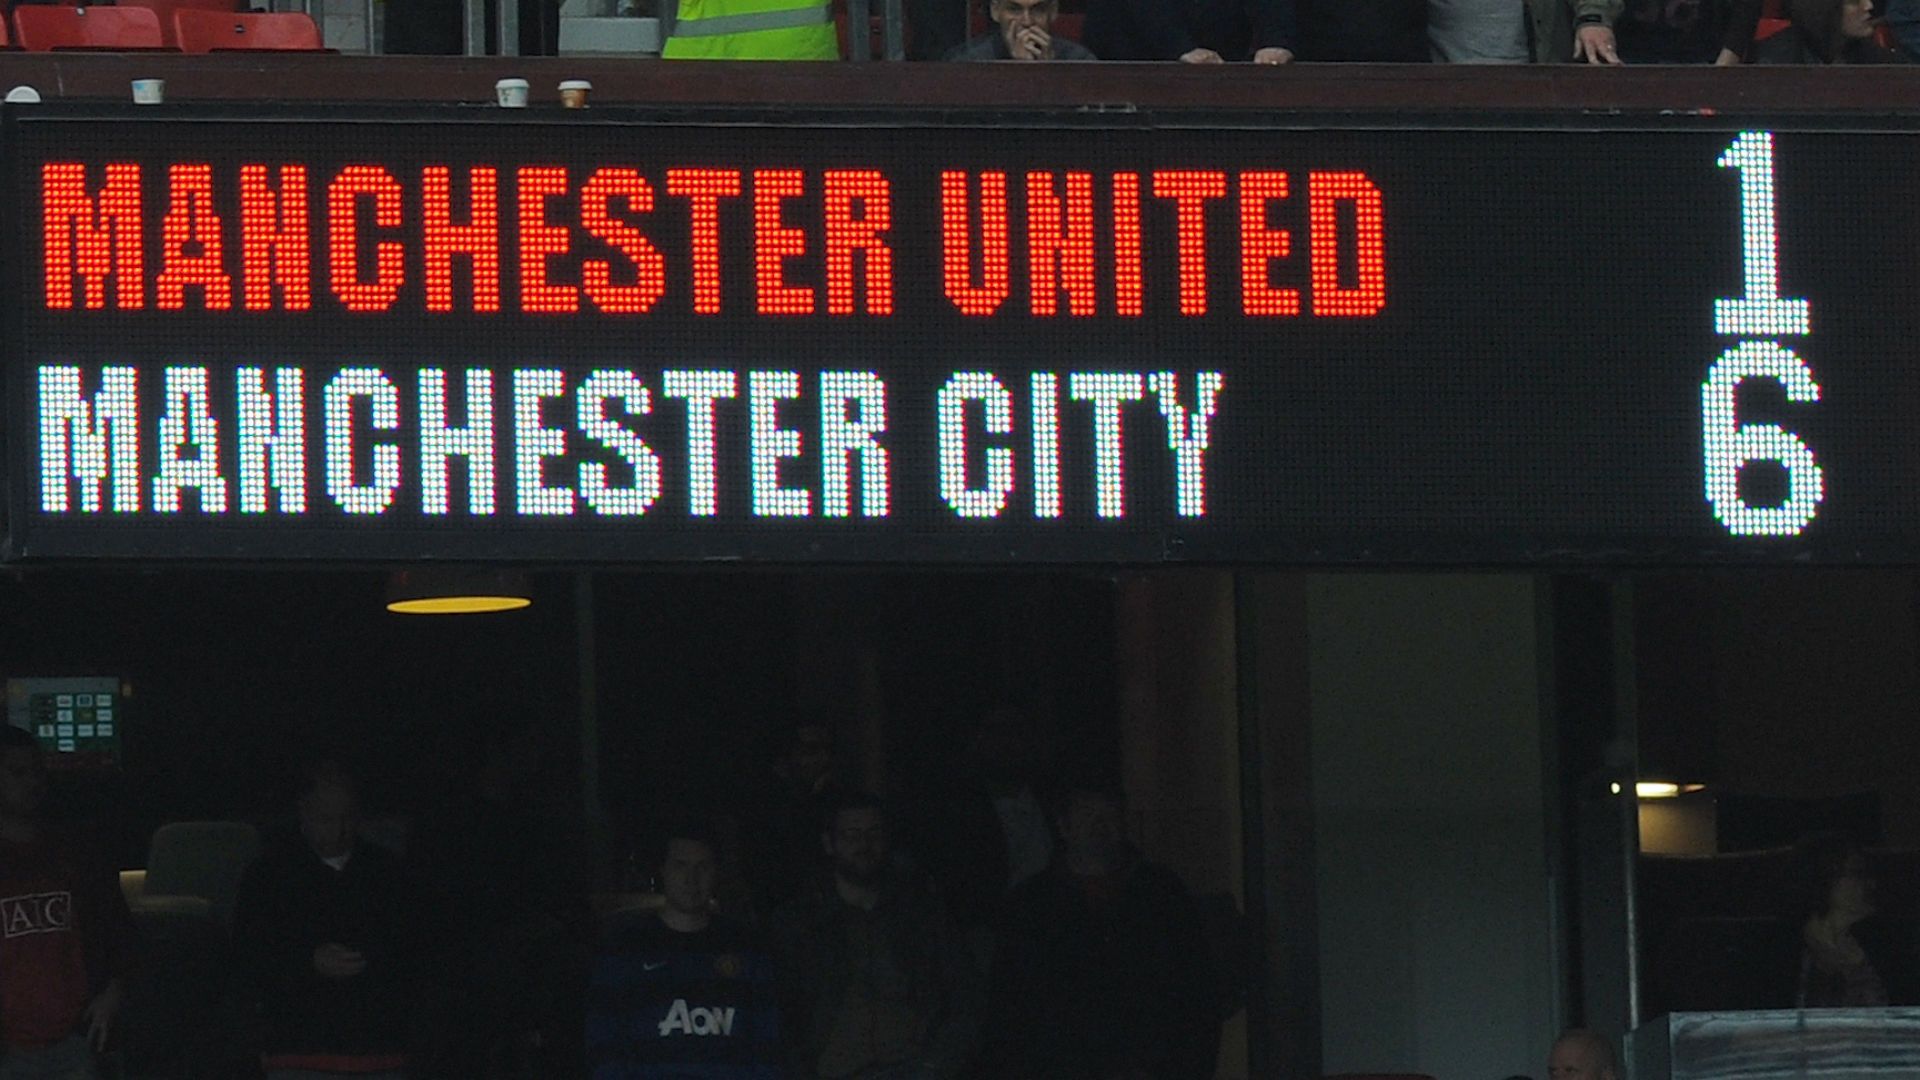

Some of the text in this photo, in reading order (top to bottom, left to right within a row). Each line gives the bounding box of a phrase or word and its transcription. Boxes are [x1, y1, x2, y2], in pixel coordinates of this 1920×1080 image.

[42, 131, 1811, 335] MANCHESTER UNITED 1
[38, 341, 1825, 536] MANCHESTER CITY 6
